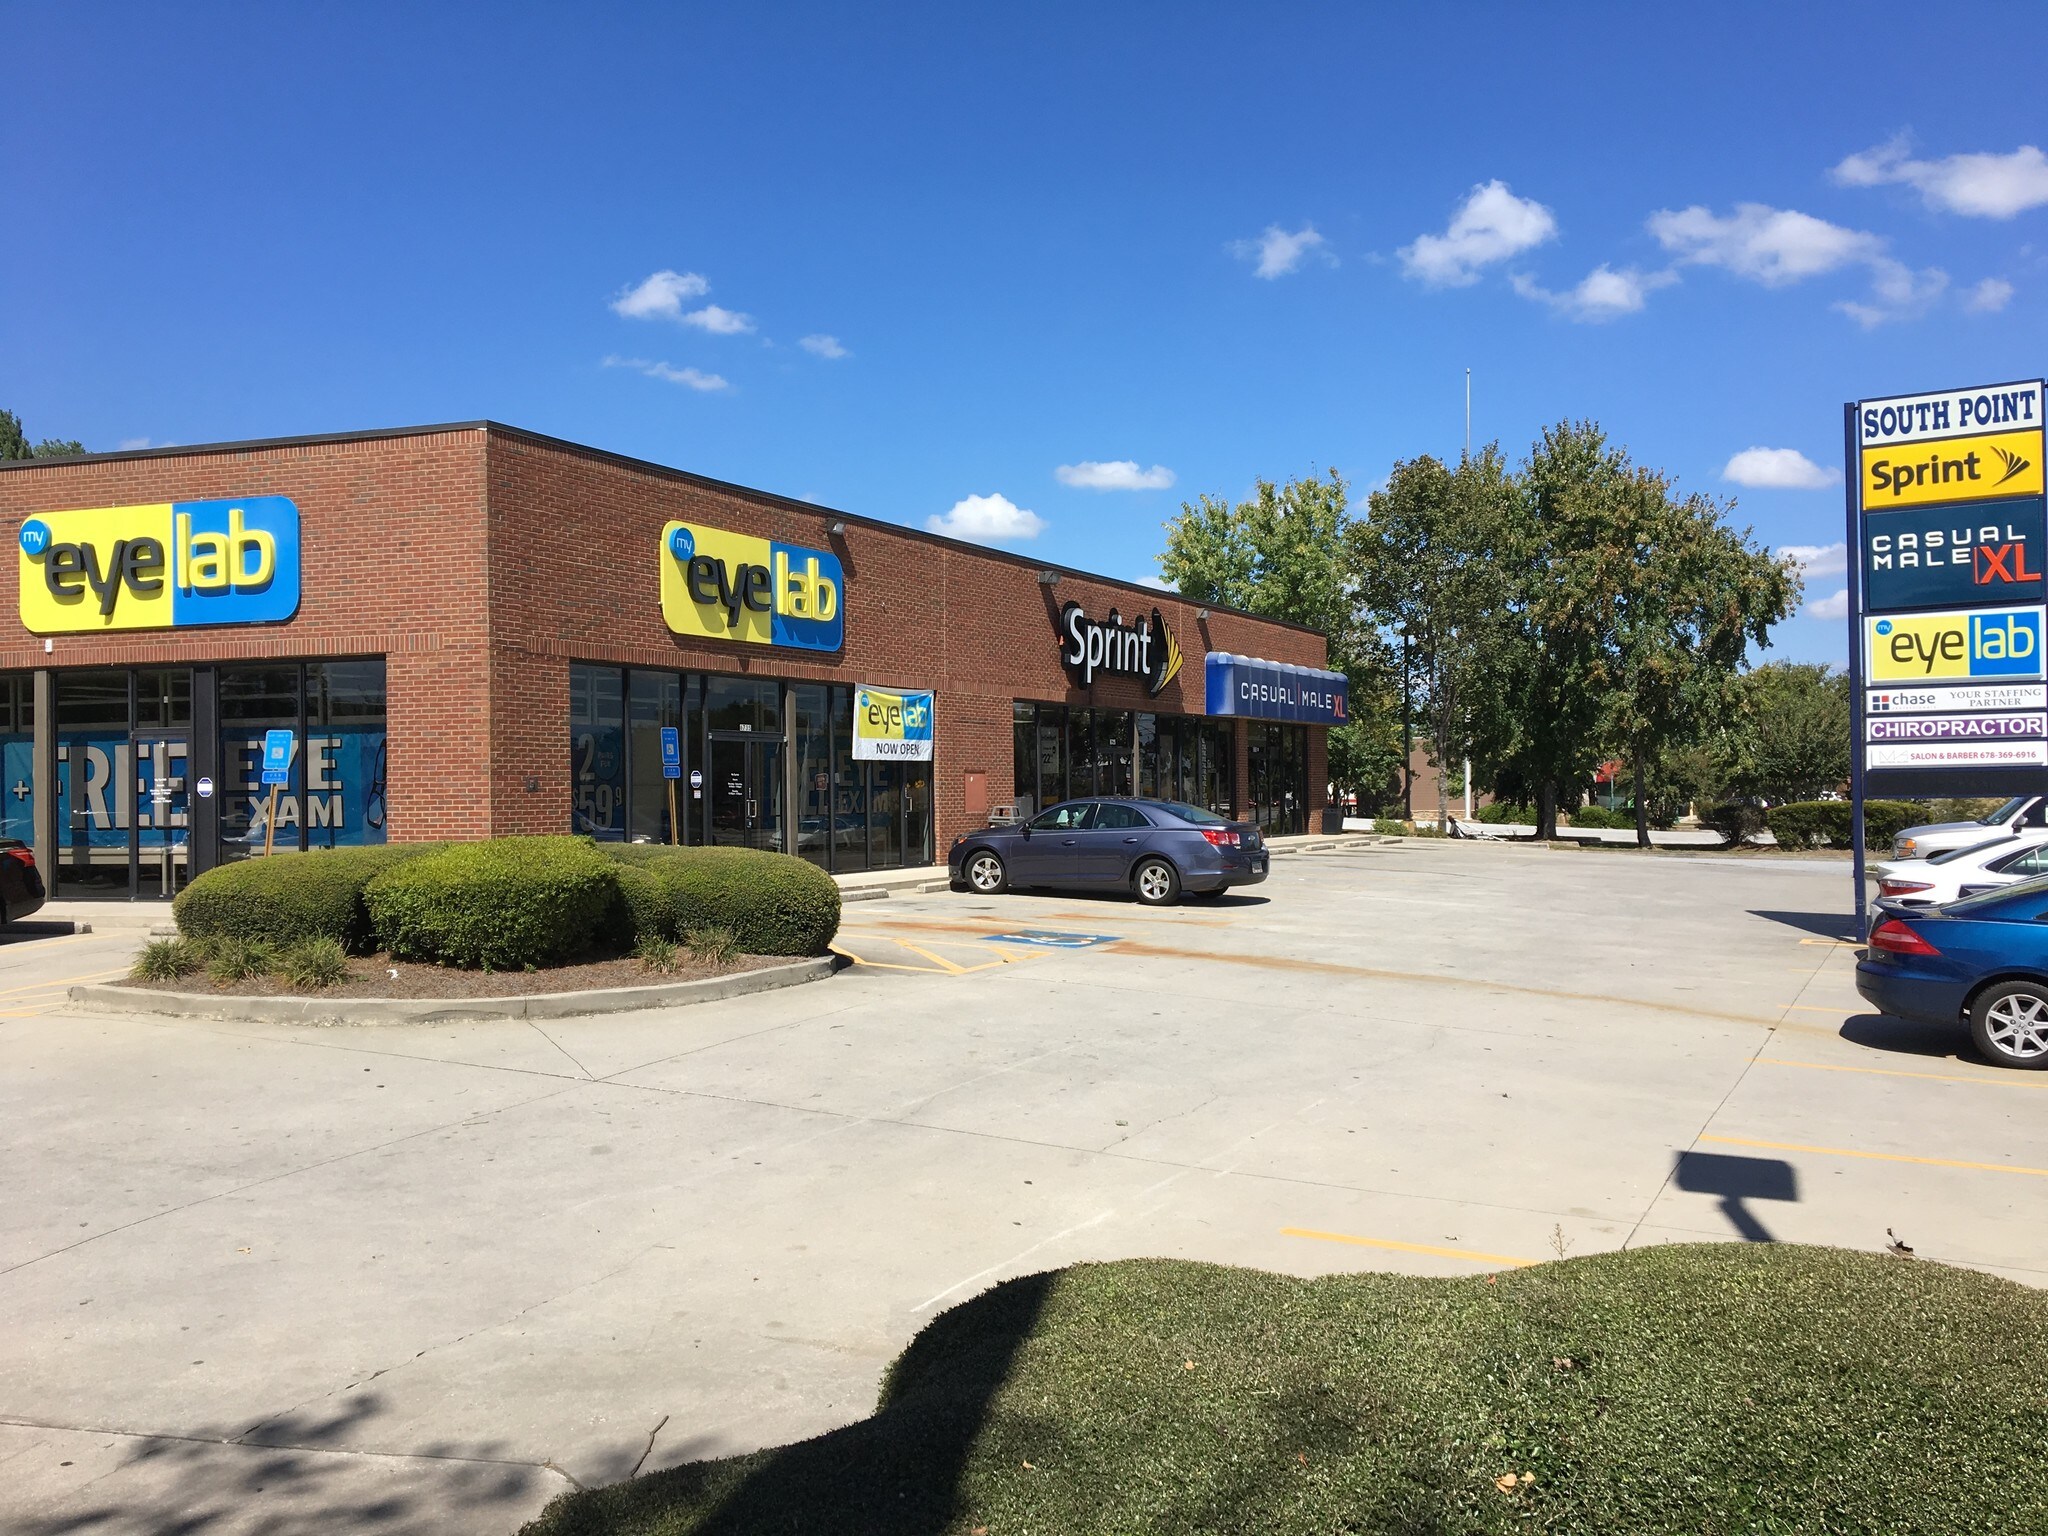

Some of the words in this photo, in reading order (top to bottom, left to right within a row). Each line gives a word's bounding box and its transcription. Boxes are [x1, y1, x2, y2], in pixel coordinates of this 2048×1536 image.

[1863, 400, 1951, 439] SOUTH
[1959, 389, 2036, 427] POINT
[1871, 451, 1981, 496] Sprint
[23, 529, 44, 546] my
[676, 537, 693, 553] my
[1872, 525, 2026, 552] CASUAL
[1873, 547, 1971, 571] MALE
[1978, 543, 2042, 586] XL
[1066, 606, 1152, 684] Sprint
[1240, 681, 1295, 705] CASUAL
[1302, 689, 1332, 710] MALE
[1333, 694, 1346, 719] XL
[1892, 692, 1936, 706] chase
[1950, 690, 1981, 699] YOUR
[1984, 688, 2042, 698] STAFFING
[1969, 697, 2022, 708] PARTNER
[1871, 717, 2042, 738] CHIROPRACTOR
[876, 743, 898, 754] NOW
[900, 743, 920, 755] OPEN
[1910, 752, 1938, 761] SALON
[1939, 752, 1945, 760] &
[1946, 751, 1979, 760] BARBER
